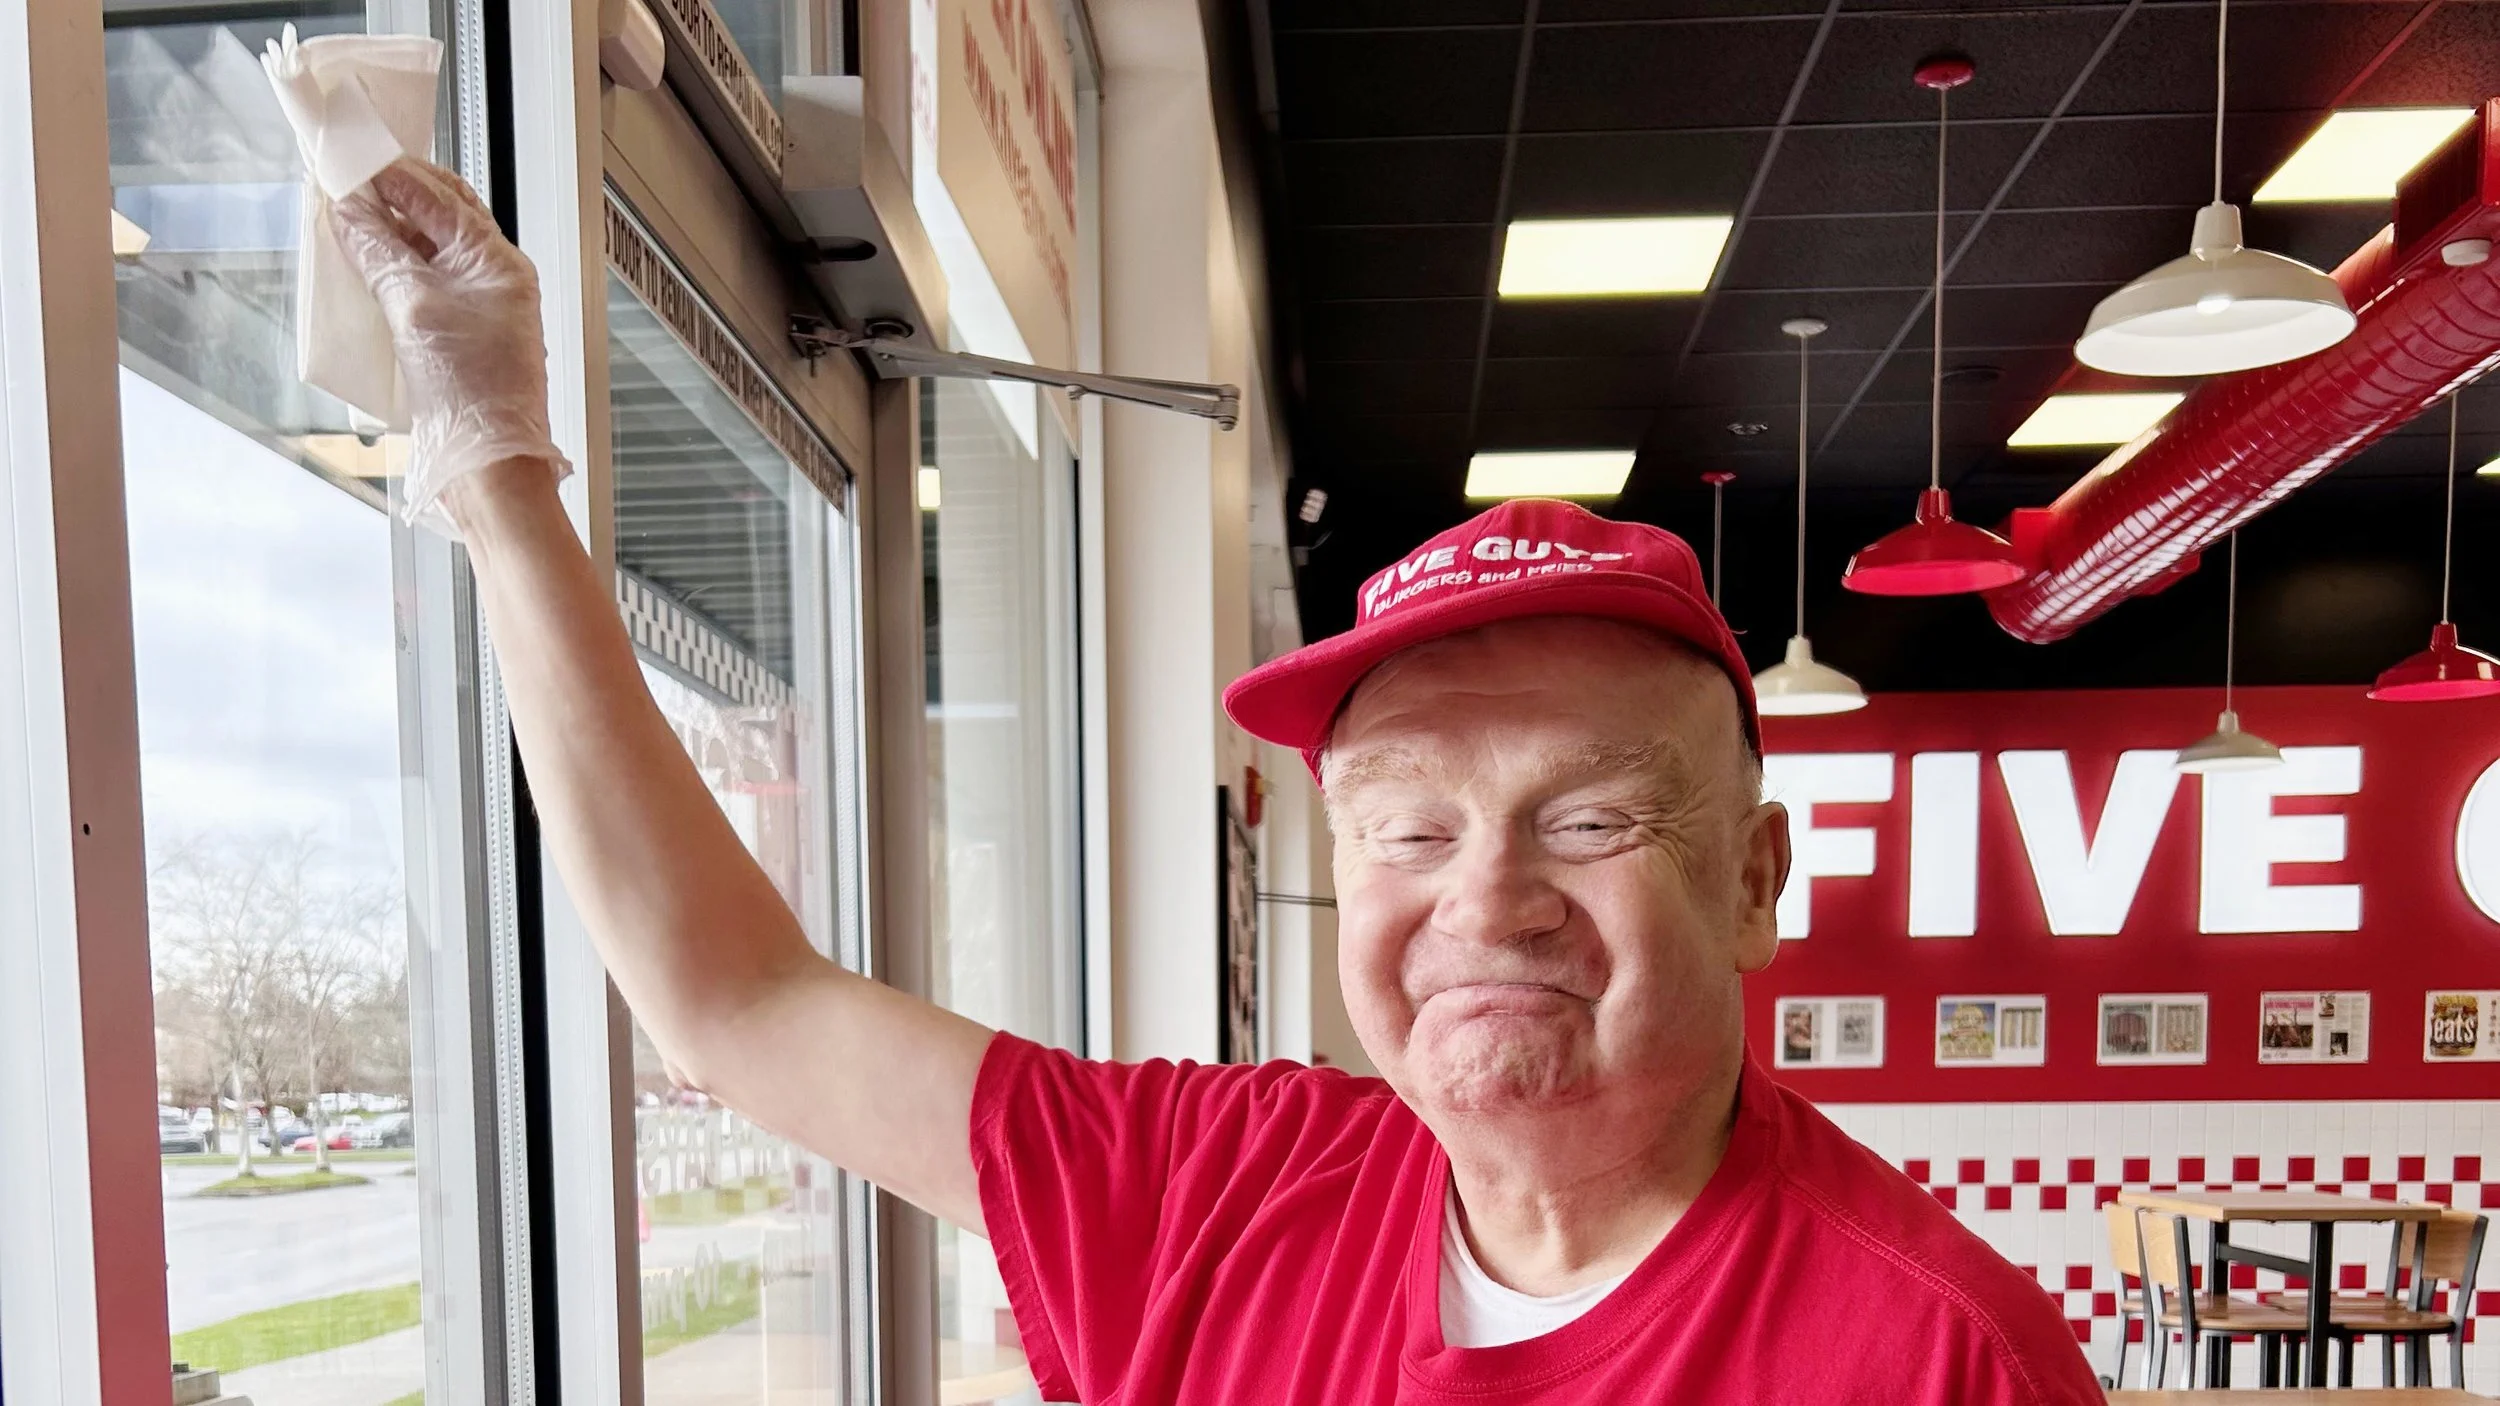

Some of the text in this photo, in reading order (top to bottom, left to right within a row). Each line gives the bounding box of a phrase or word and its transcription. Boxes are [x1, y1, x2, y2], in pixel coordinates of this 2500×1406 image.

[701, 8, 715, 67] TO
[717, 33, 752, 125] REMAIN
[613, 209, 643, 290] DOOR
[644, 246, 657, 307] TO
[660, 264, 696, 349] REMAIN
[699, 304, 740, 397] UNLOCKED
[1364, 545, 1460, 619] FIVE
[1373, 563, 1594, 618] BURGERS and FRIES
[1762, 746, 2363, 940] FIVE
[2434, 1012, 2475, 1043] eats
